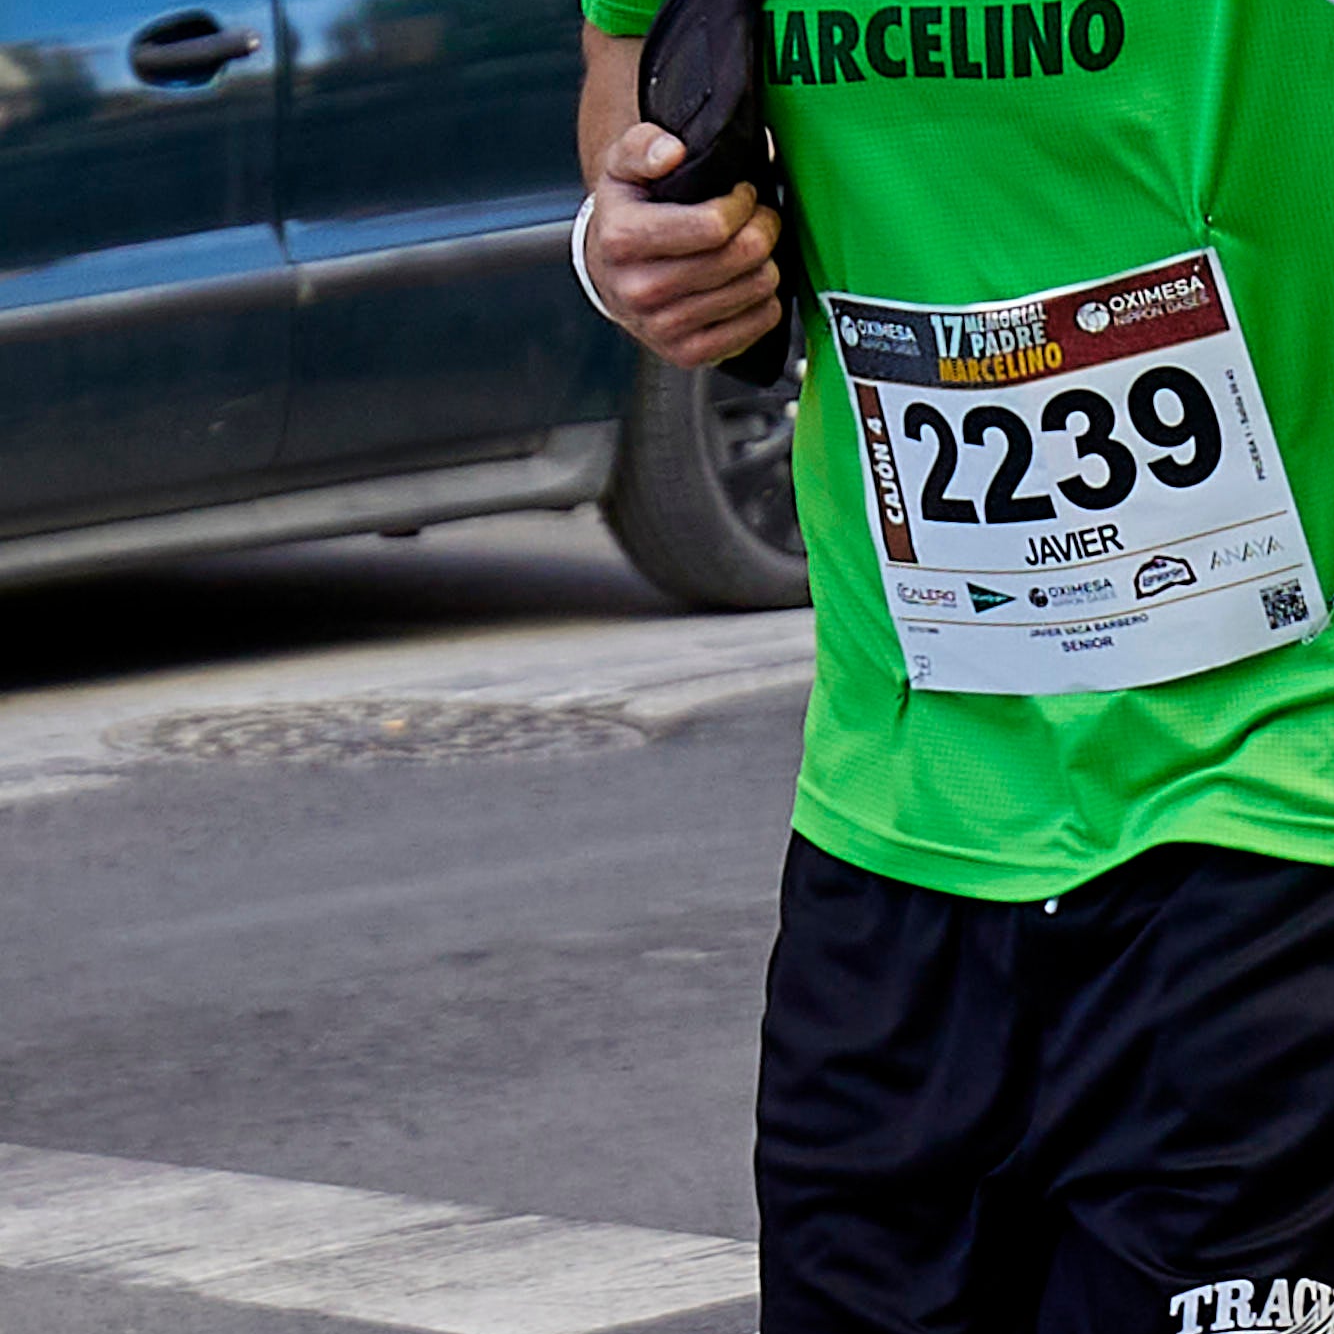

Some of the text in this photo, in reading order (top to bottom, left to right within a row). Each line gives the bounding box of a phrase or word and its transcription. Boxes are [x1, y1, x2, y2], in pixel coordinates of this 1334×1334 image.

[1109, 275, 1205, 311] OXIMESA
[930, 313, 963, 358] 17
[963, 302, 1048, 333] MEMORIAL
[970, 323, 1048, 358] PADRE
[939, 341, 1063, 383] MARCELINO
[903, 366, 1222, 525] 2239
[866, 416, 905, 526] CAJÓN 4
[1025, 523, 1124, 565] JAVIER
[1210, 535, 1285, 571] ANAYA
[1048, 577, 1114, 598] OXIMESA
[1061, 636, 1115, 653] SENIOR
